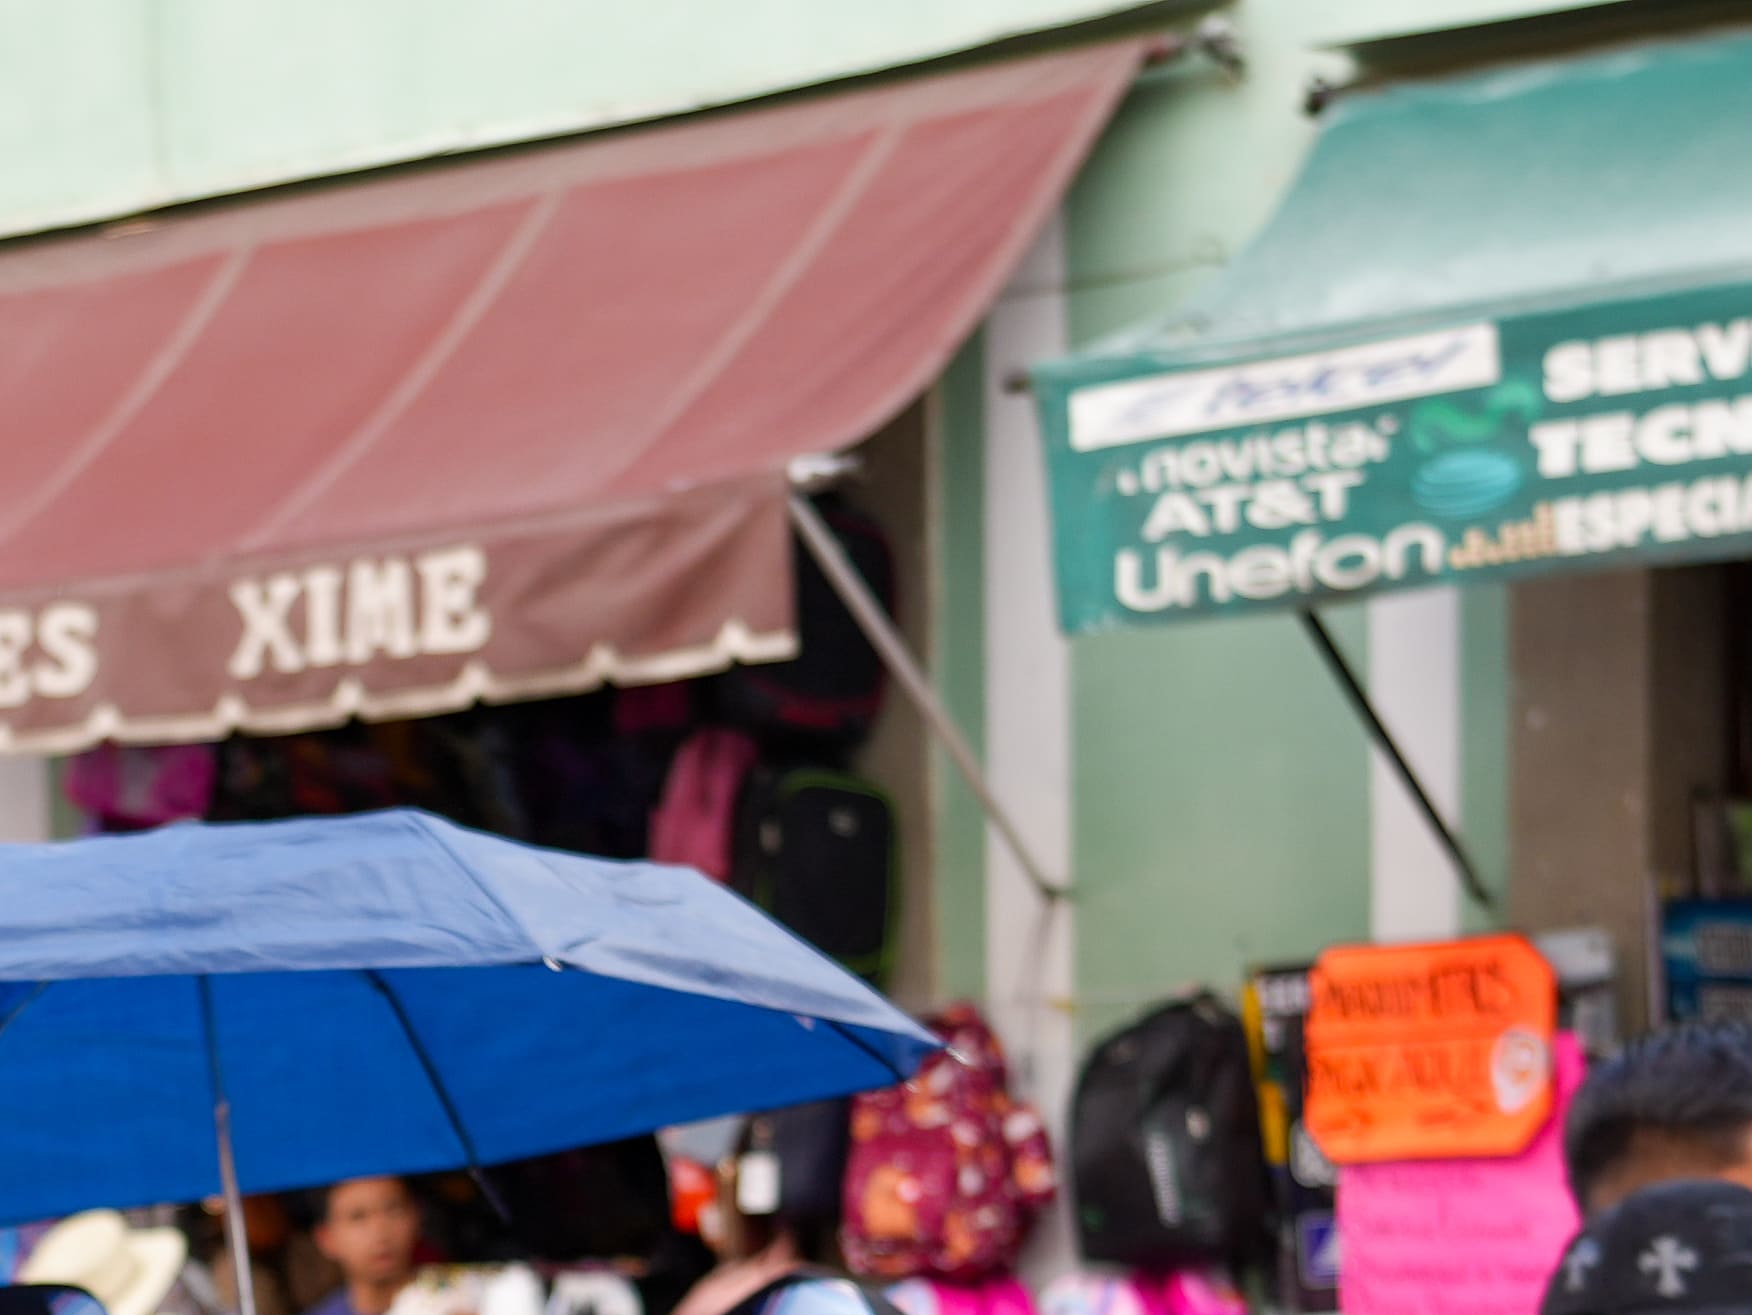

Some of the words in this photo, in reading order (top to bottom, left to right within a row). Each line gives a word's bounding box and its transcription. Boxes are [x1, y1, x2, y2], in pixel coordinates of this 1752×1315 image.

[1142, 470, 1366, 541] AT&T
[230, 547, 490, 677] XIME
[1114, 522, 1445, 612] Unefon
